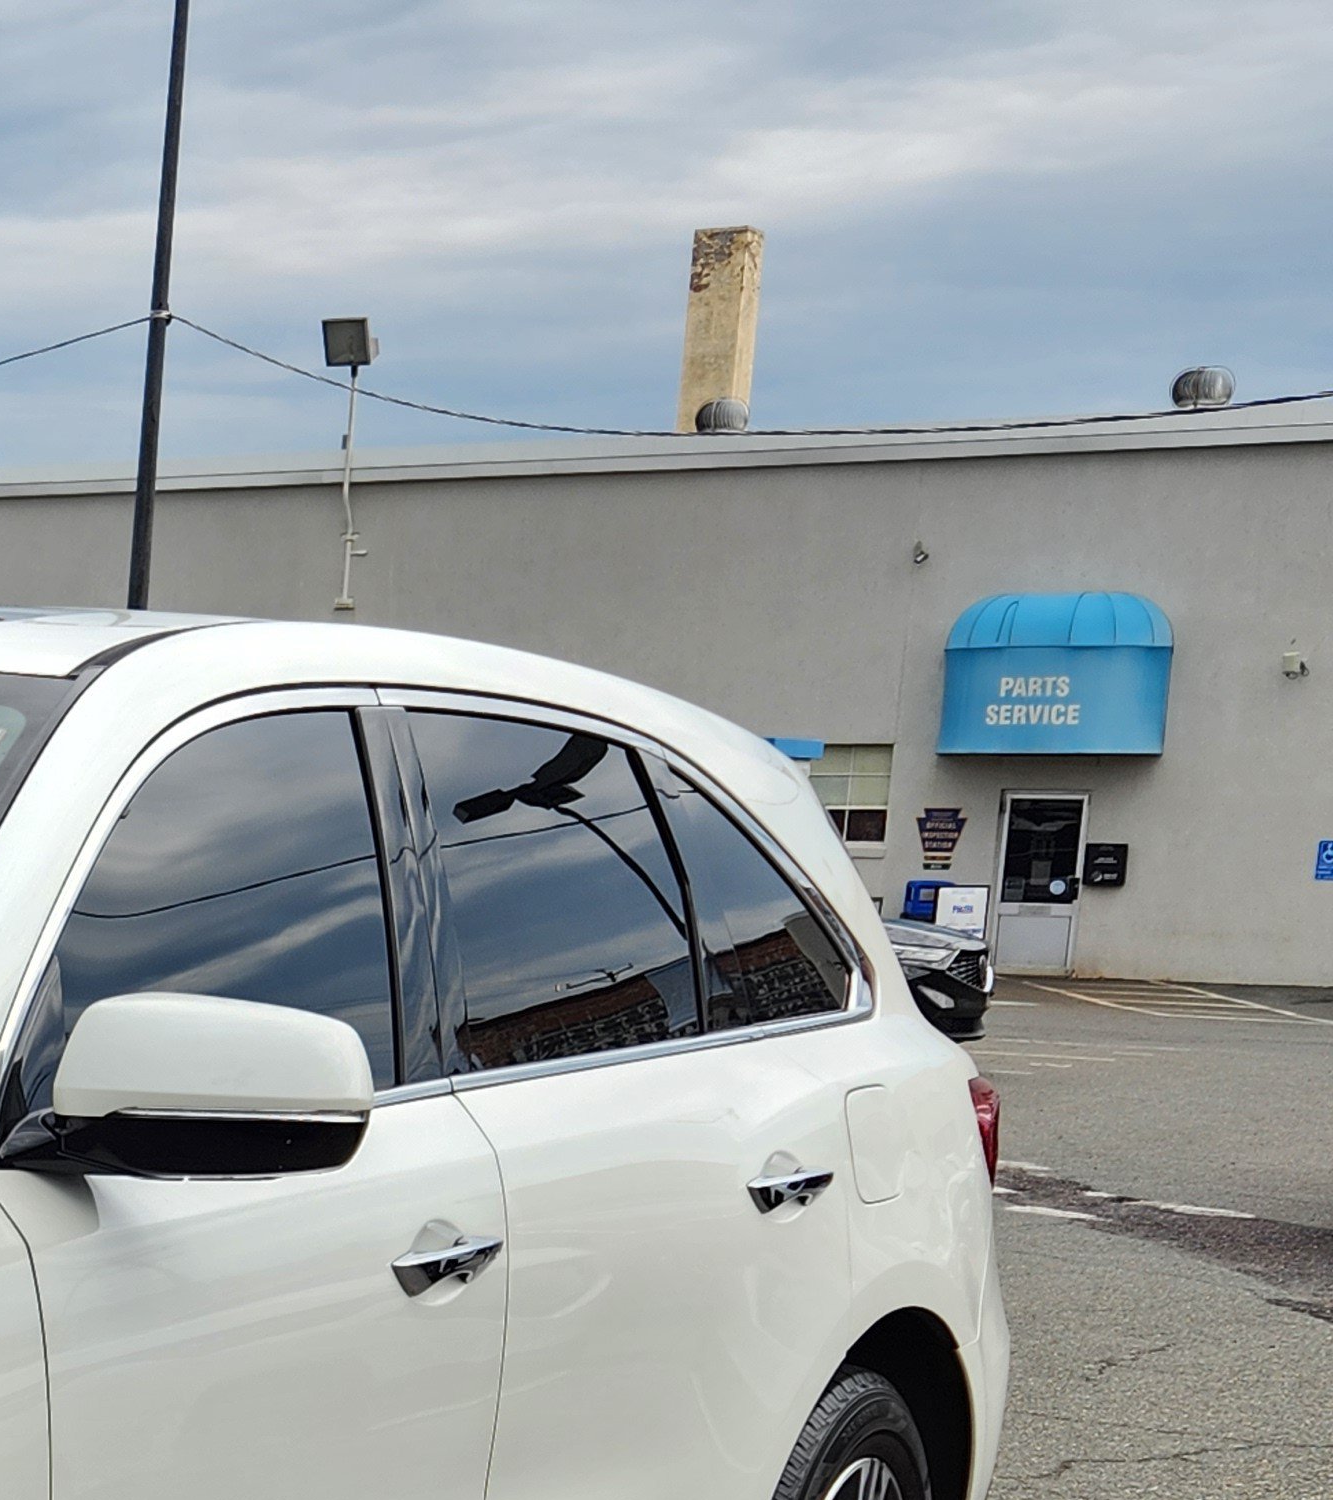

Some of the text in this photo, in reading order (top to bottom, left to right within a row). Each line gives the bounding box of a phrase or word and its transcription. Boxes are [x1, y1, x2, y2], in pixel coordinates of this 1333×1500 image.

[999, 676, 1071, 698] PARTS
[985, 704, 1081, 725] SERVICE
[925, 821, 957, 829] OFFICIAL
